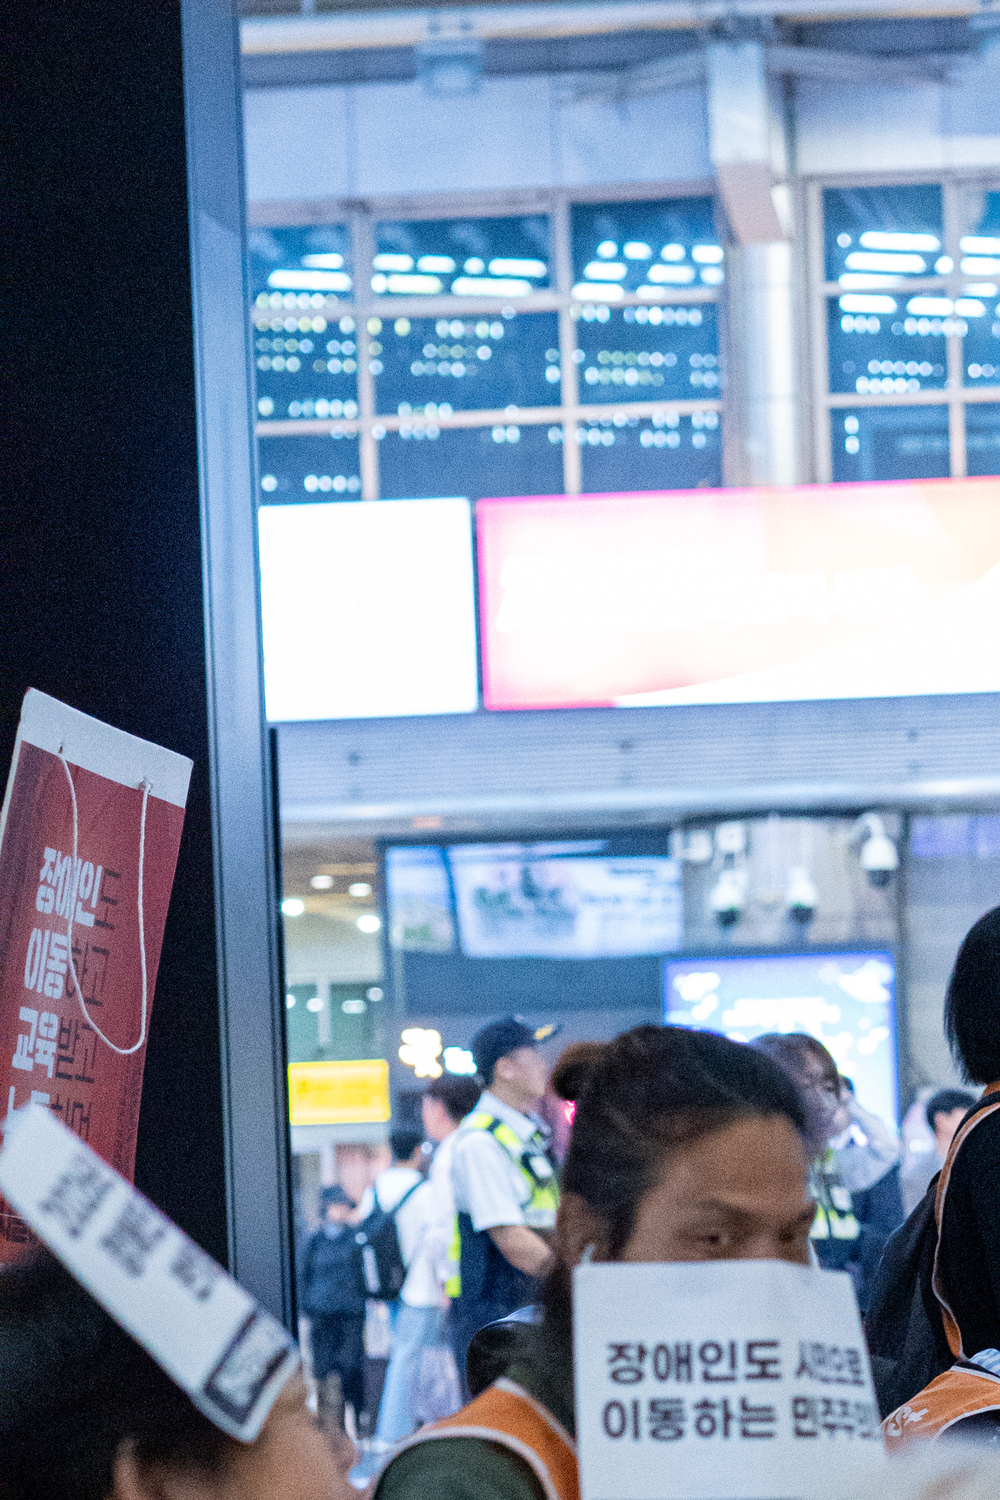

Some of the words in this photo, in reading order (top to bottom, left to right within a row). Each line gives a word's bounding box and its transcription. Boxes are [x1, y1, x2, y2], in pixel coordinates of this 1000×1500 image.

[35, 846, 121, 930] 장애인도
[12, 1006, 98, 1084] 교육받고
[607, 1338, 782, 1385] 장애인도
[603, 1396, 776, 1441] 이동하는
